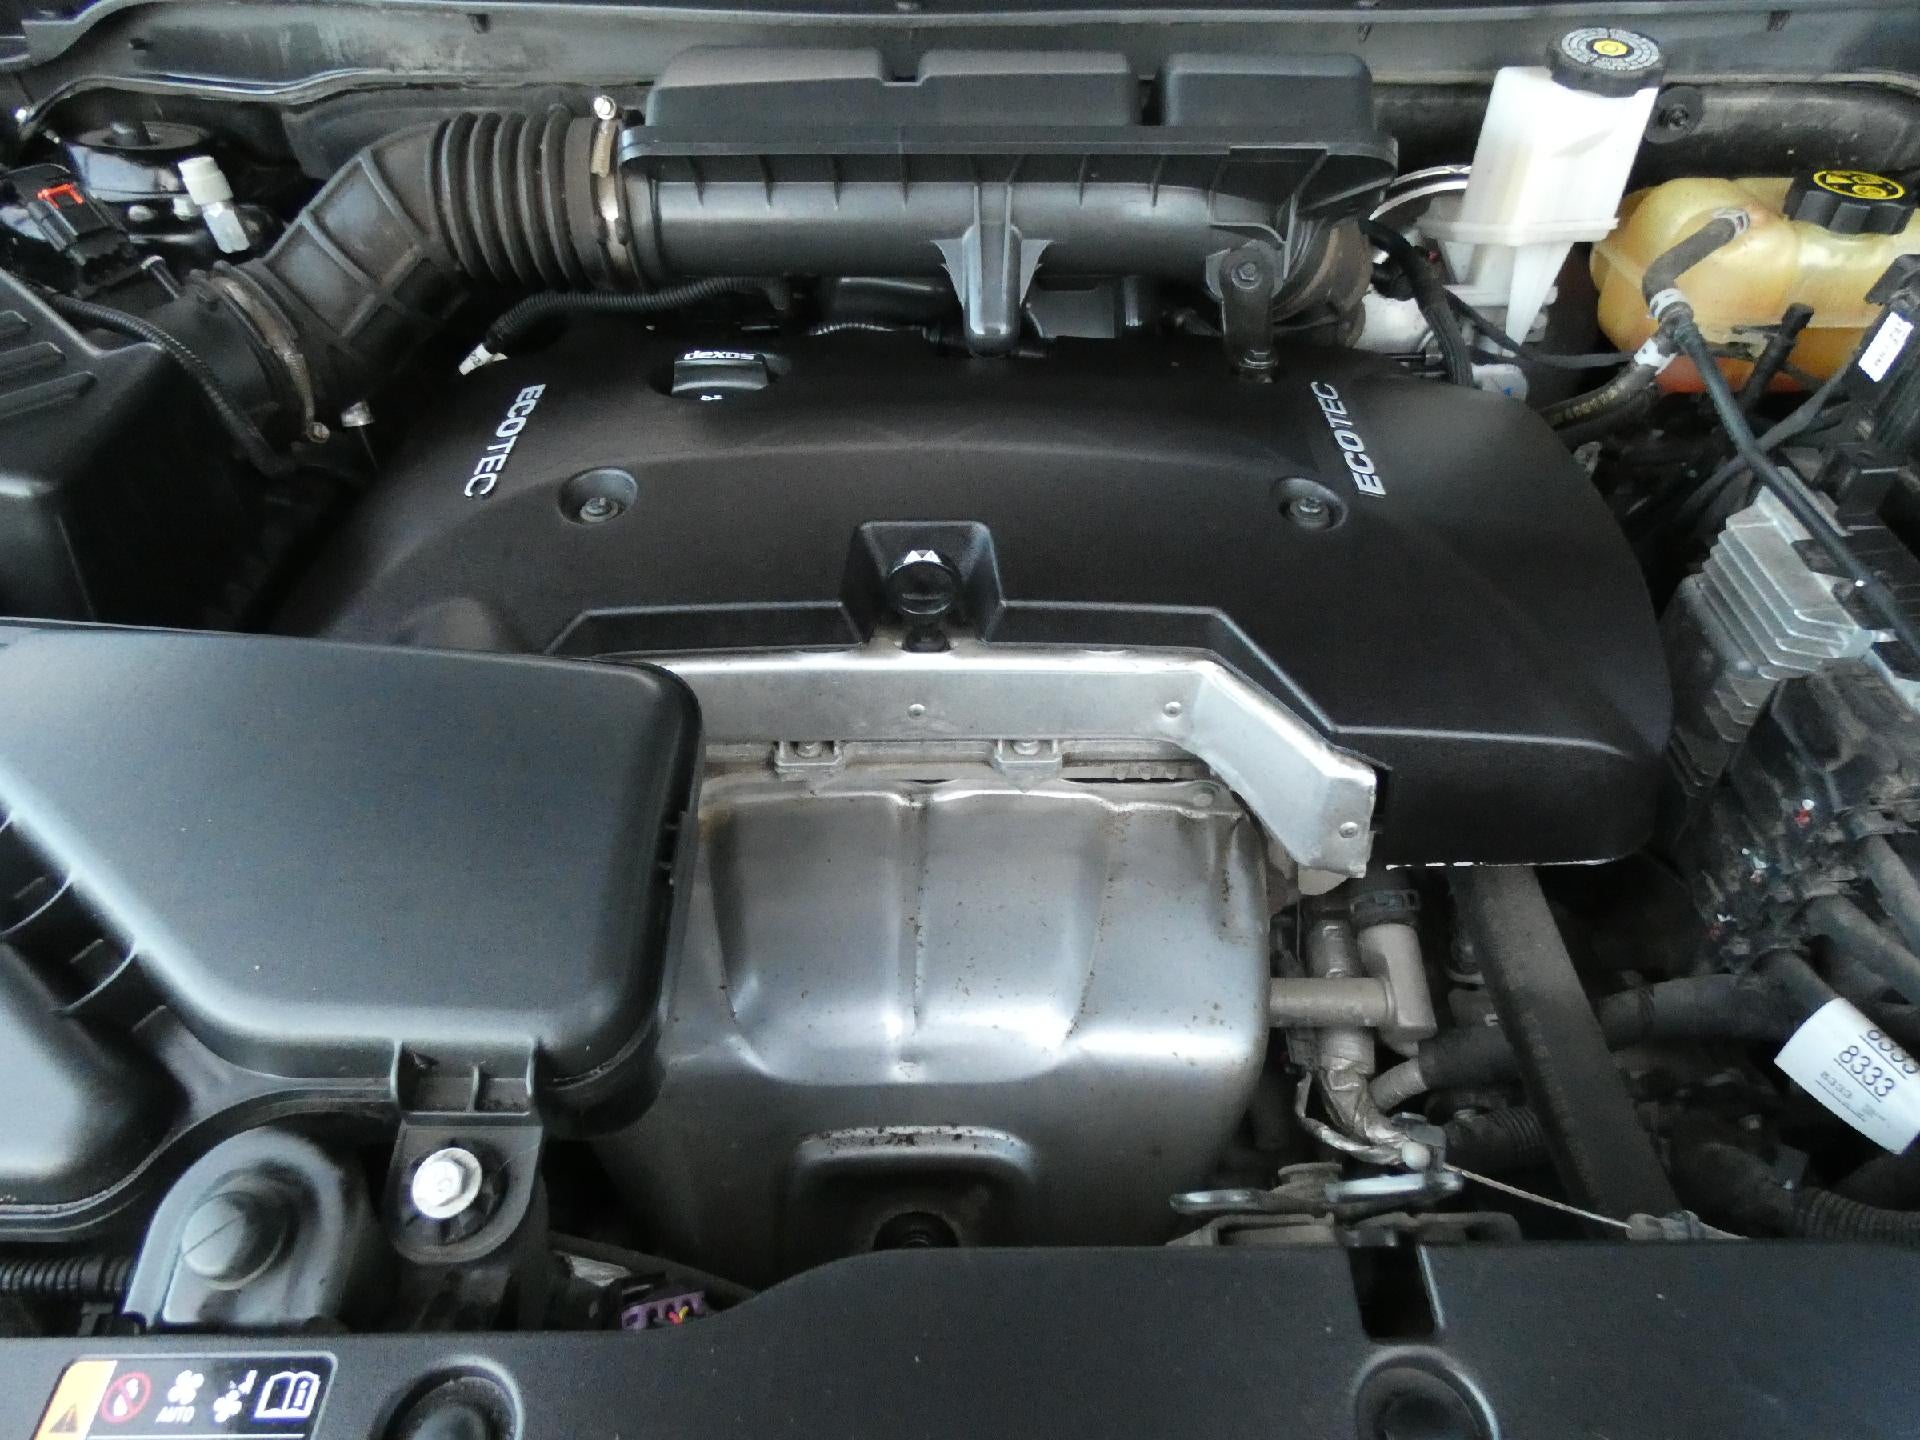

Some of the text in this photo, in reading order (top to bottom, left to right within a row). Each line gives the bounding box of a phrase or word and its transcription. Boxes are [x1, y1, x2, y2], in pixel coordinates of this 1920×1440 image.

[684, 350, 756, 361] dexos
[464, 383, 547, 497] ECOTEC
[1310, 381, 1387, 496] ECOTEC
[1838, 1045, 1895, 1097] 8333
[155, 1406, 196, 1423] AUTO
